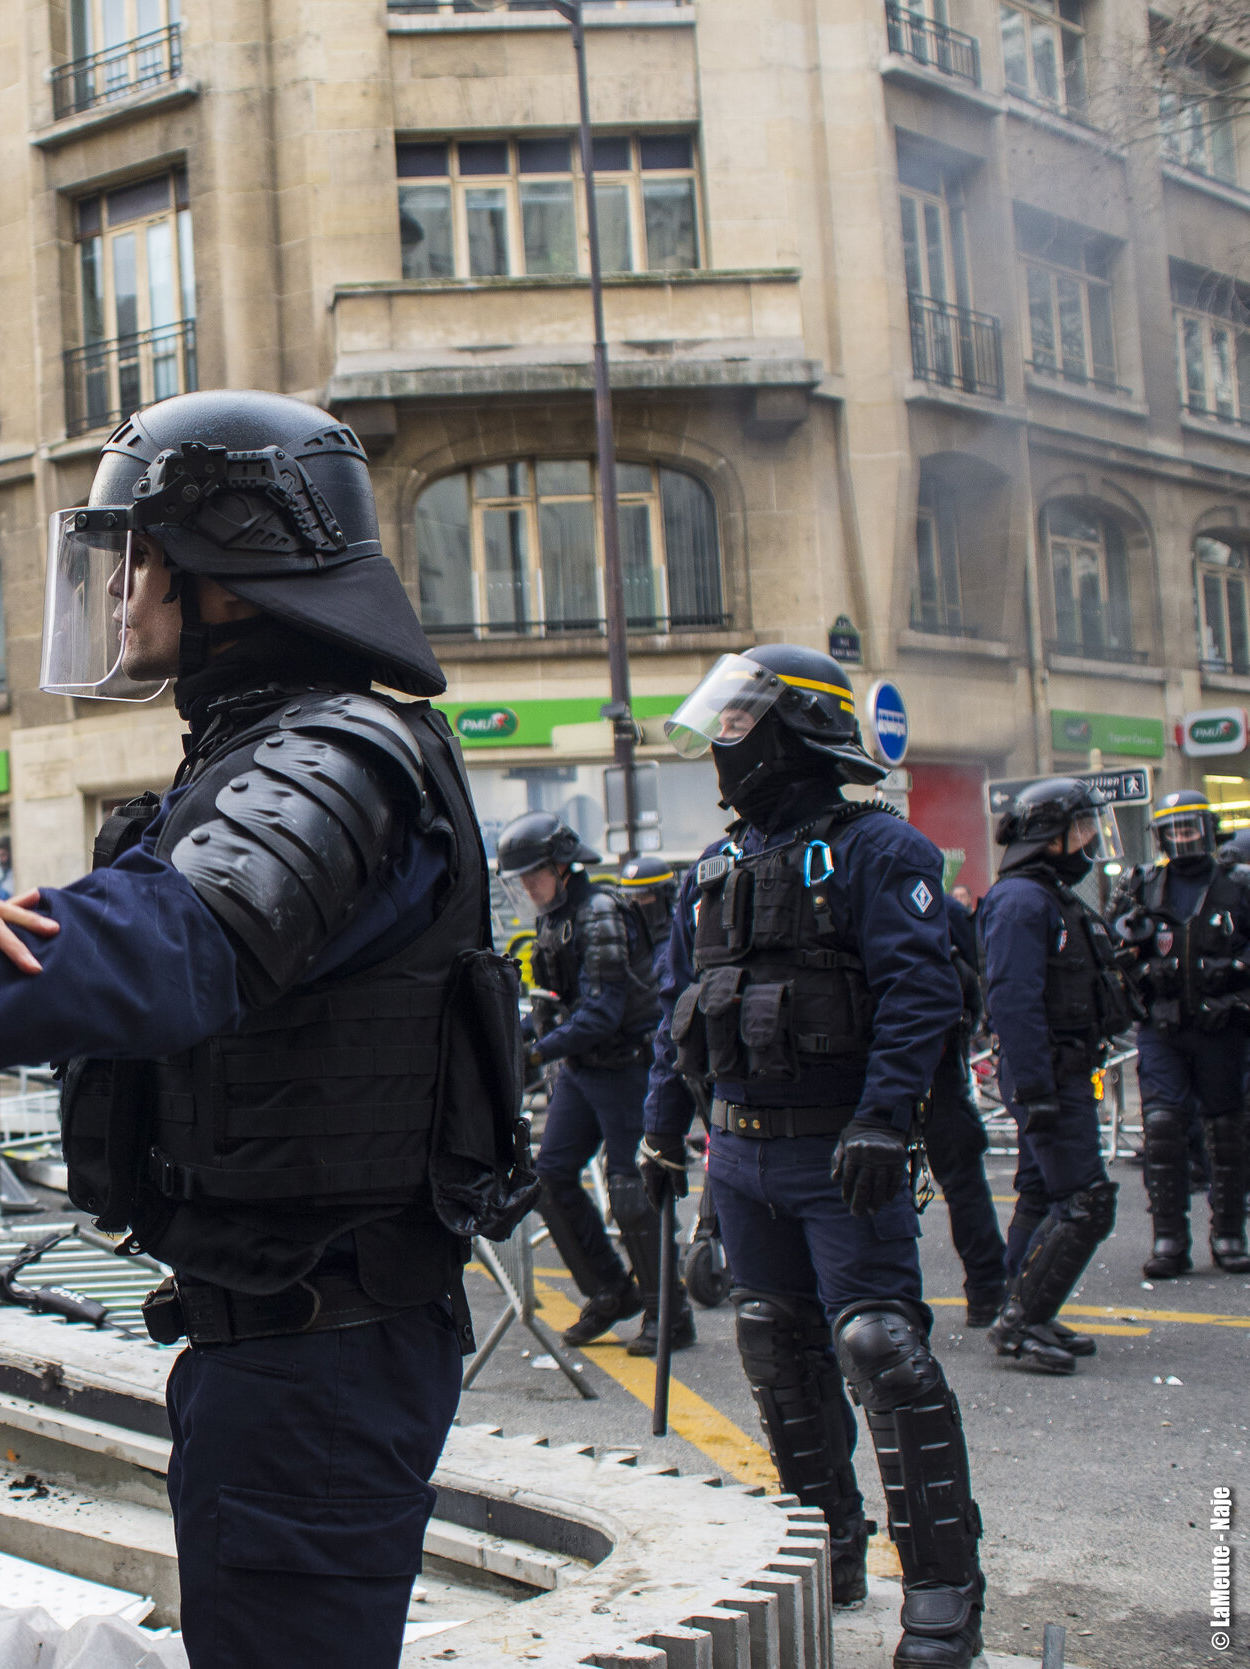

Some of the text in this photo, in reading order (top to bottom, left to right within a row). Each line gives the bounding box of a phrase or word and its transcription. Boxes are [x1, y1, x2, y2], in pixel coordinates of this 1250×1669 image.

[461, 718, 492, 731] PMU
[1193, 727, 1220, 738] PMU
[50, 1286, 85, 1304] dott
